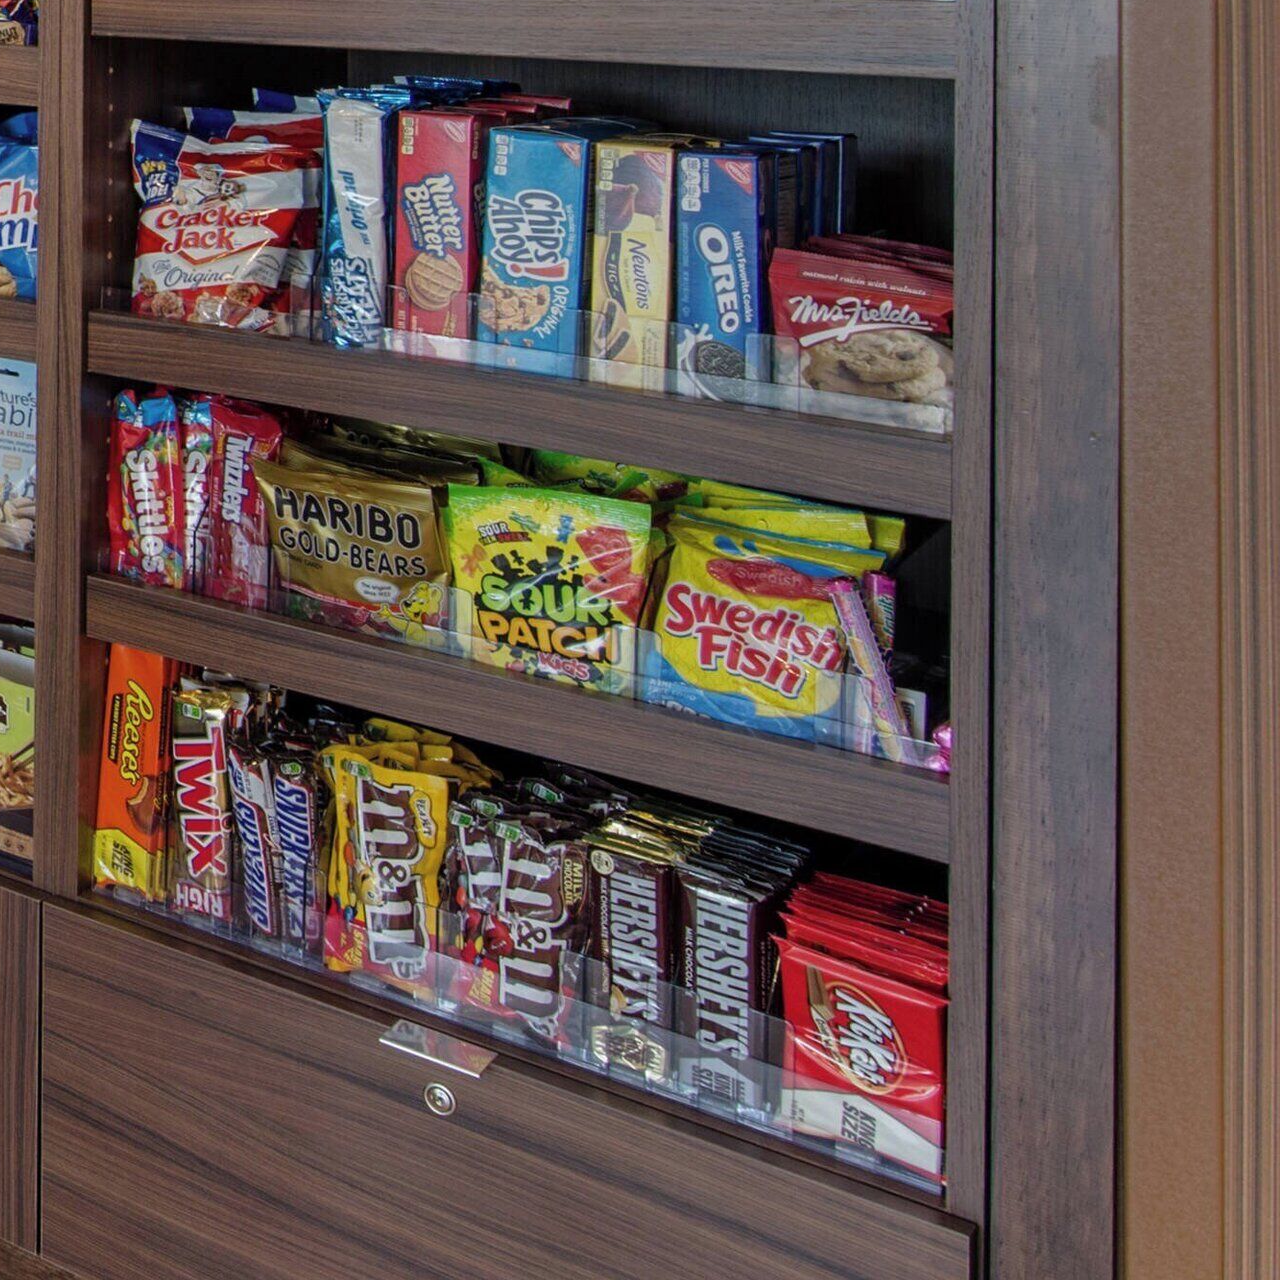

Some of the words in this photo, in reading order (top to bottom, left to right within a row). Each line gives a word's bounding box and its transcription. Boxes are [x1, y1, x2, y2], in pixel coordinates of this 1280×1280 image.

[154, 205, 264, 231] Cracker
[403, 184, 444, 258] Butter
[426, 174, 463, 251] Nutter
[519, 191, 561, 264] Chips
[161, 224, 236, 254] Jack
[732, 231, 743, 257] Milk's
[606, 263, 620, 286] FIG
[627, 237, 651, 311] Newtons
[699, 225, 739, 333] OREO
[737, 257, 749, 291] Favorite
[802, 270, 838, 281] oatmeal
[345, 257, 382, 343] TREATS
[532, 286, 570, 338] ORIGINAL
[742, 293, 753, 323] Cookie
[789, 295, 842, 324] Mrs.
[838, 296, 929, 336] Fields
[221, 436, 253, 524] Twizzlers
[125, 449, 168, 573] Skittles
[272, 486, 422, 551] HARIBO
[478, 521, 509, 538] SOUR
[278, 526, 427, 577] GOLD-BEARS
[480, 573, 612, 624] SOUR
[476, 610, 619, 663] PATCH
[664, 584, 844, 672] Swedish
[694, 625, 807, 698] Fish
[120, 679, 153, 785] Reese's
[173, 722, 228, 877] TWIX
[111, 840, 123, 872] SIZE
[121, 845, 135, 879] KING
[177, 883, 226, 918] RIGH
[563, 858, 573, 906] CHOCOLATE
[572, 862, 586, 908] MILK
[609, 871, 660, 1022] HERSHEY'S
[695, 891, 750, 1061] HERSHEY'S
[842, 1100, 858, 1142] SIZE
[858, 1108, 876, 1148] KING
